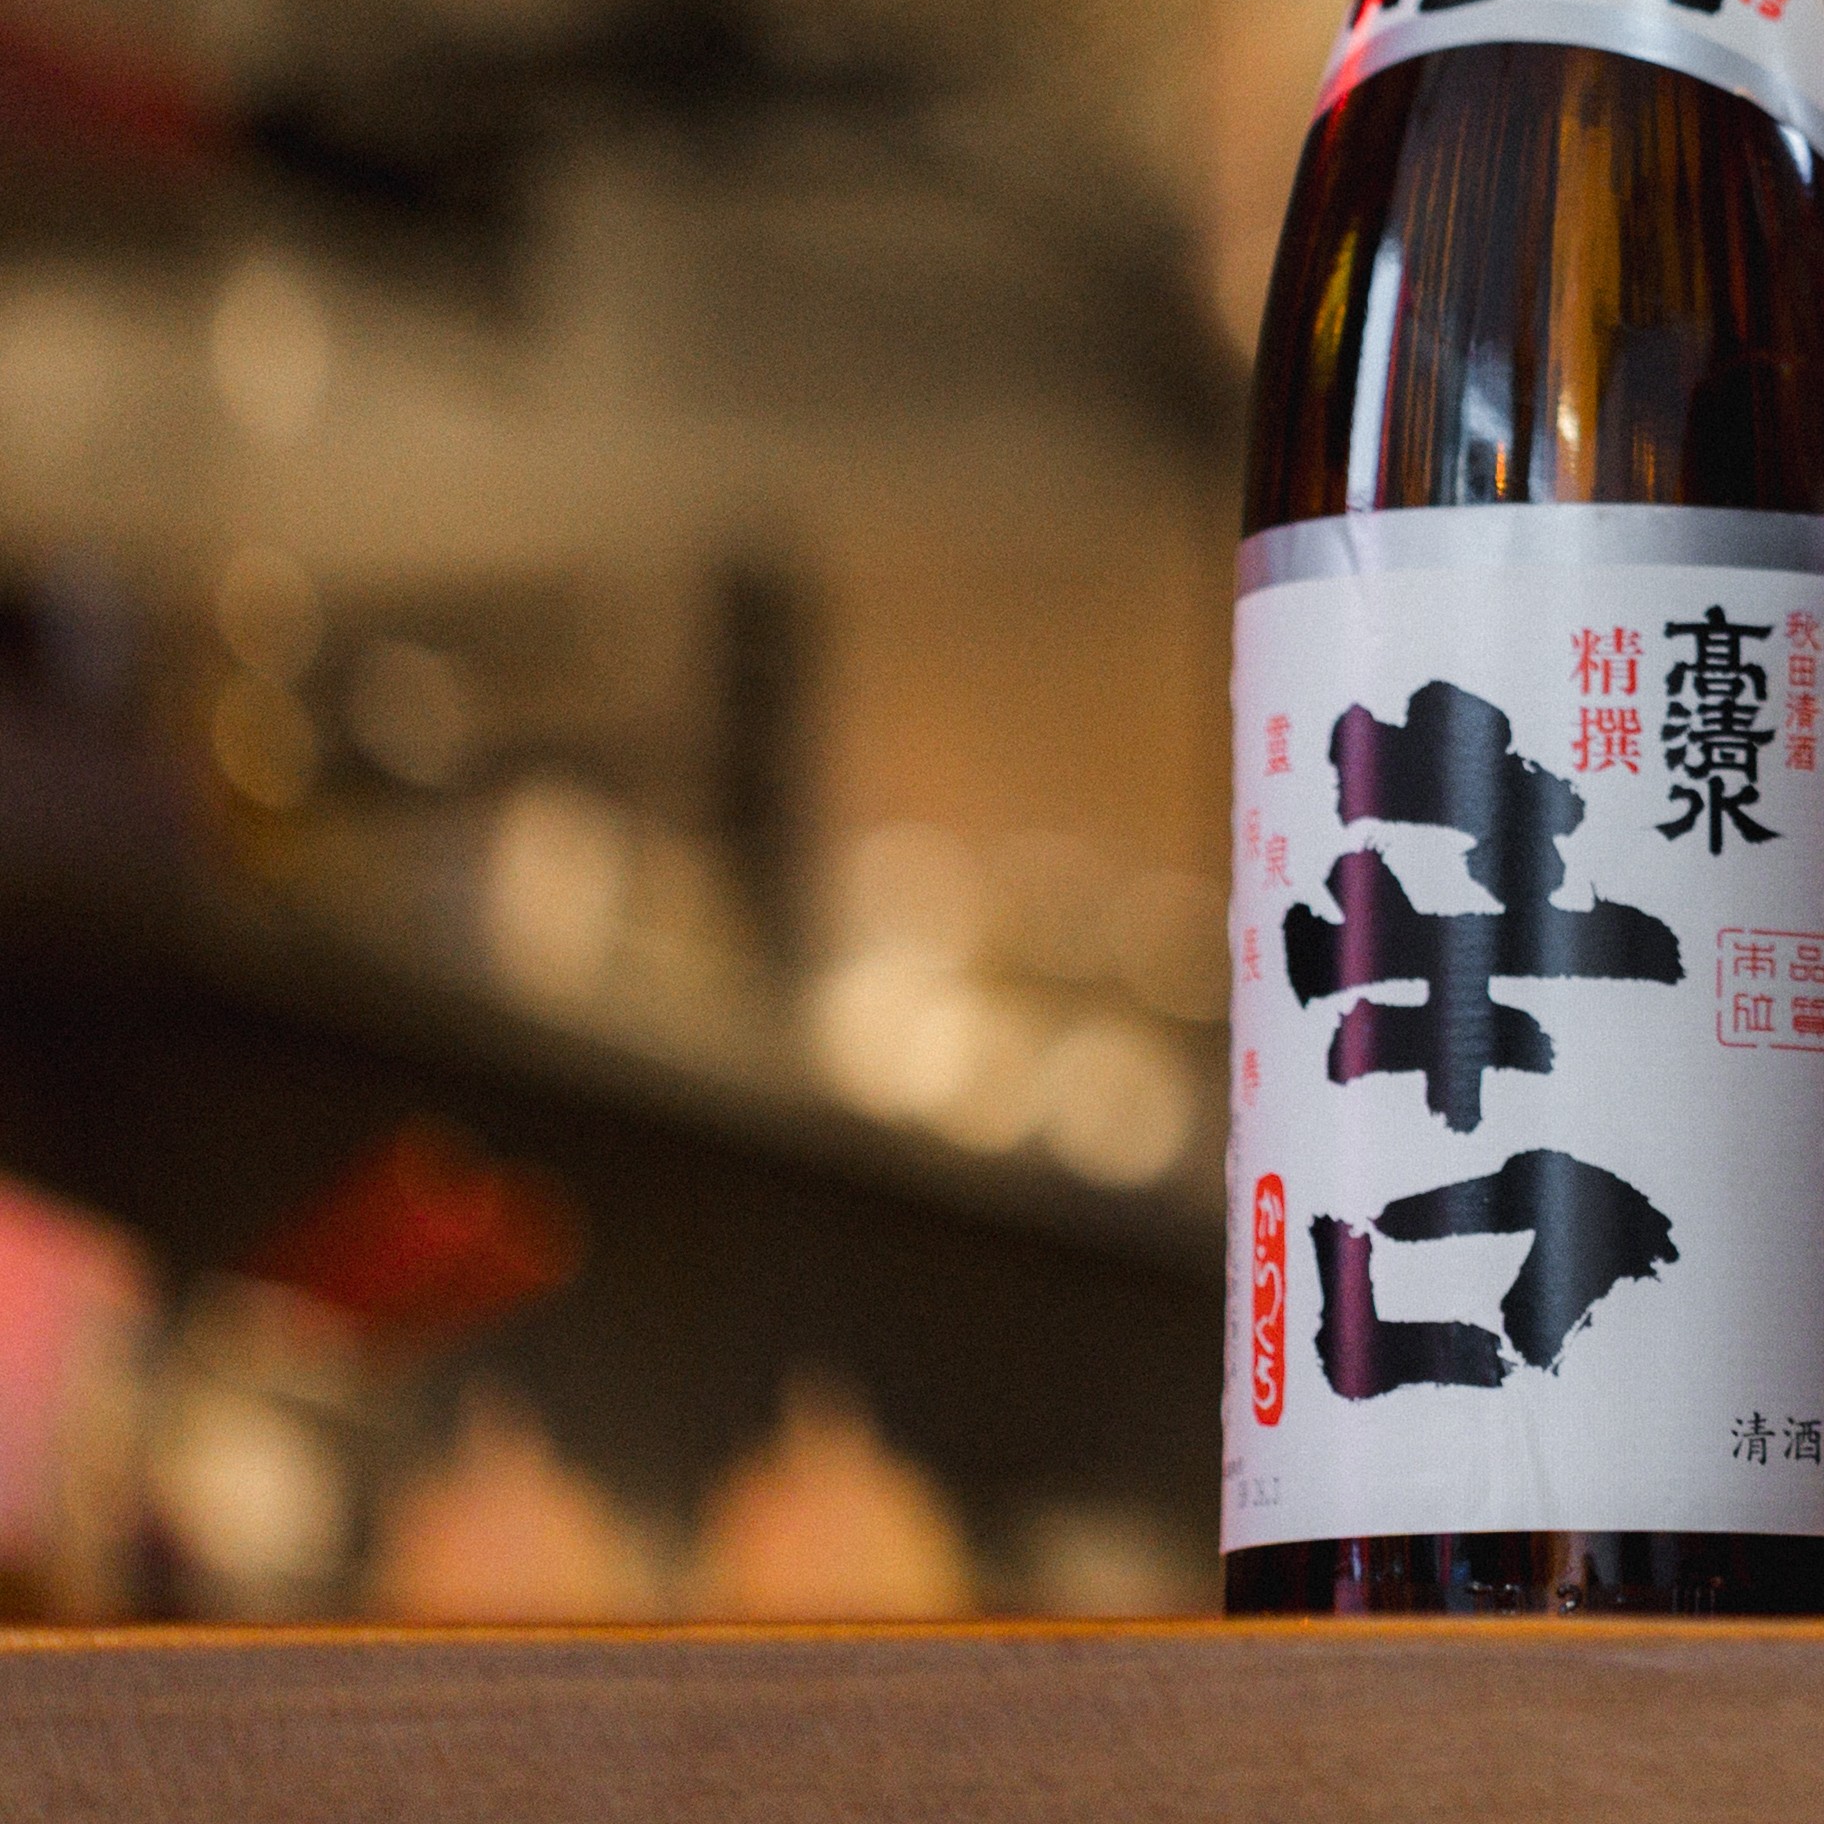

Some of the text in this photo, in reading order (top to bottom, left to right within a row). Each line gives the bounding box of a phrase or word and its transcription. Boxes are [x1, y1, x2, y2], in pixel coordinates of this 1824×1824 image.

[1785, 609, 1821, 773] 秋田清酒
[1283, 679, 1686, 1401] 辛口
[1729, 1411, 1824, 1466] 清酒
